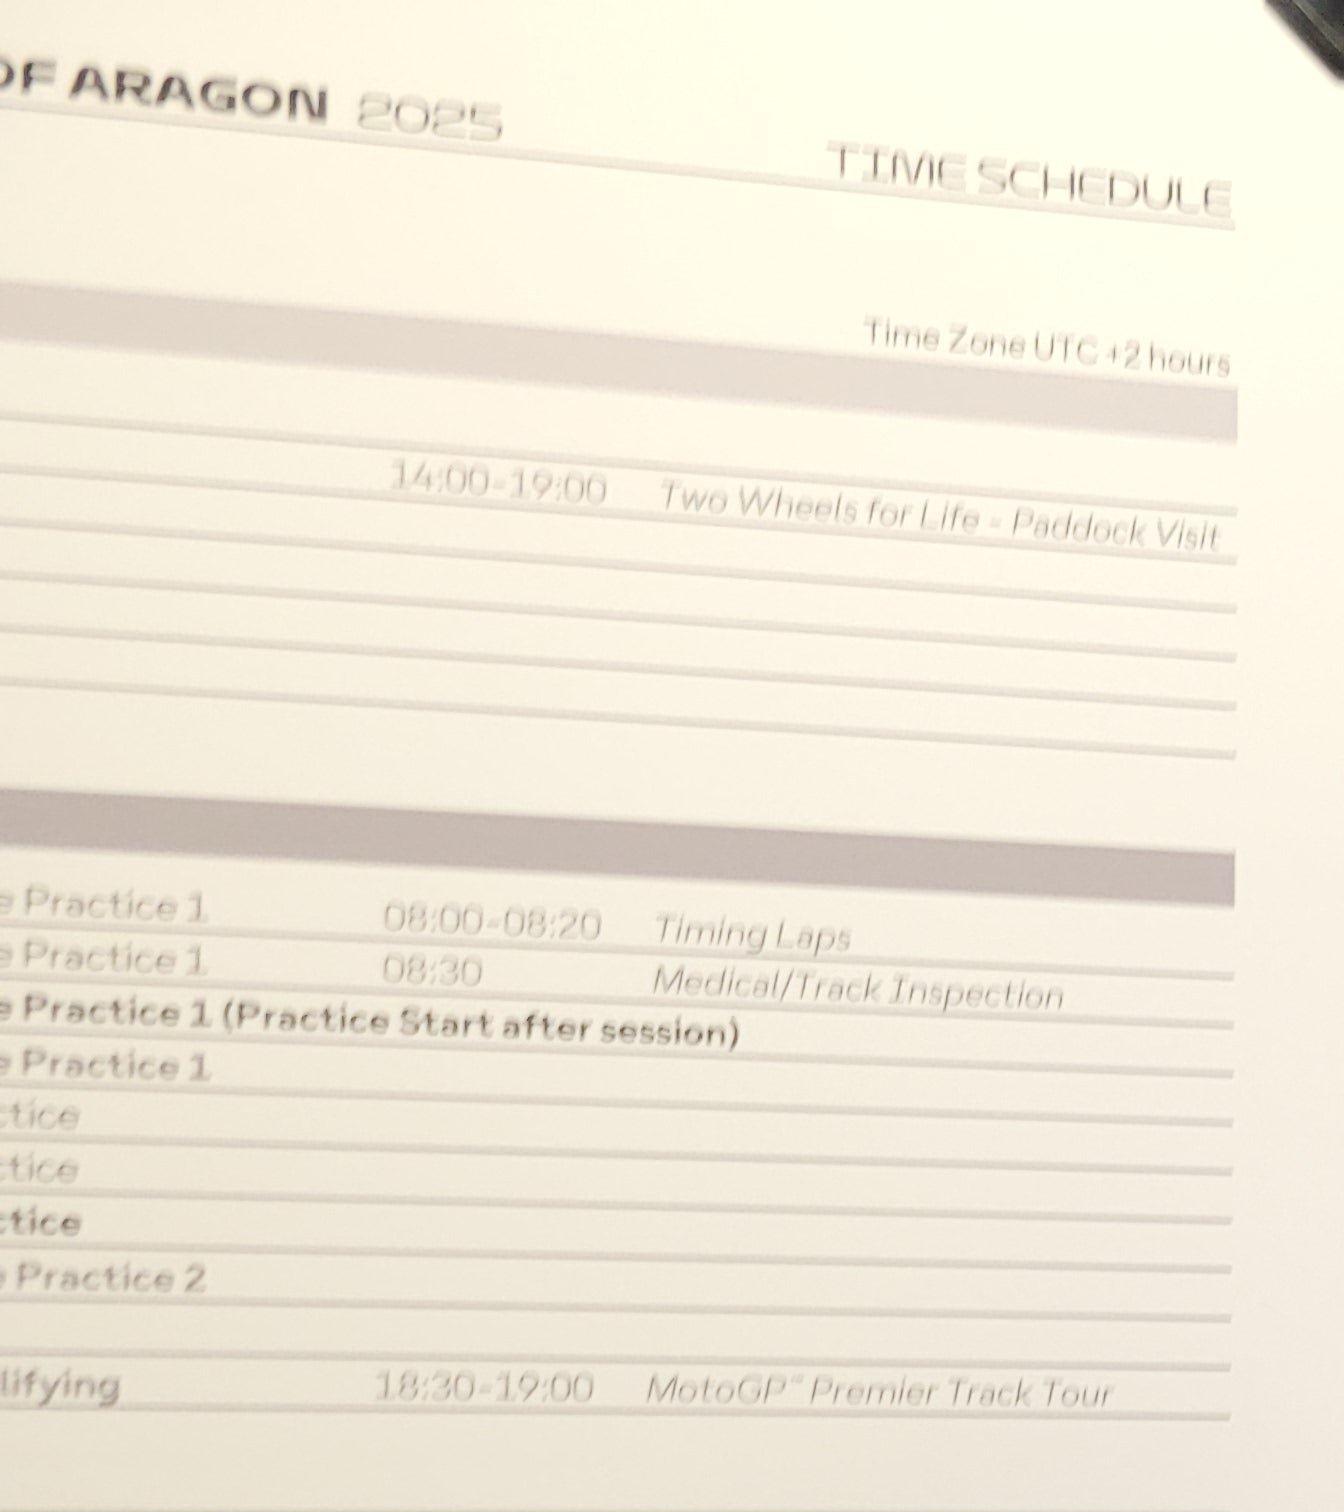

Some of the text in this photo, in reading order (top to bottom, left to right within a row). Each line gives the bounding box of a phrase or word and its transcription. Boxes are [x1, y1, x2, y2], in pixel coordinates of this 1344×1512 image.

[68, 63, 328, 125] ARAGON
[358, 93, 502, 142] 2025
[826, 139, 1232, 219] TIME SCHEDULE
[864, 314, 1231, 379] Time Zone UTC +2 hours
[391, 458, 607, 506] 14:00-19:00
[661, 477, 727, 514] Two
[738, 484, 858, 528] Wheels
[866, 494, 912, 529] for
[918, 497, 980, 536] Life
[1010, 505, 1146, 549] Paddock
[1155, 516, 1221, 553] Visit
[24, 883, 178, 922] Practice
[187, 892, 209, 923] 1
[382, 898, 852, 957] 08:00-08:20 Timing Laps
[22, 937, 176, 975] Practice
[186, 945, 209, 977] 1
[381, 951, 1065, 1013] 08:30 Medical/Track Inspection
[23, 991, 180, 1030] Practice
[189, 998, 212, 1028] 1
[223, 995, 390, 1036] (Practice
[399, 1007, 493, 1039] Start
[502, 1008, 592, 1042] after
[600, 1015, 741, 1052] session)
[21, 1044, 180, 1080] Practice
[189, 1049, 212, 1083] 1
[17, 1259, 175, 1295] Practice
[183, 1263, 207, 1293] 2
[374, 1367, 595, 1405] 18:30-19:00
[810, 1375, 938, 1407] Premier
[947, 1375, 1035, 1408] Track
[1040, 1376, 1114, 1409] Tour
